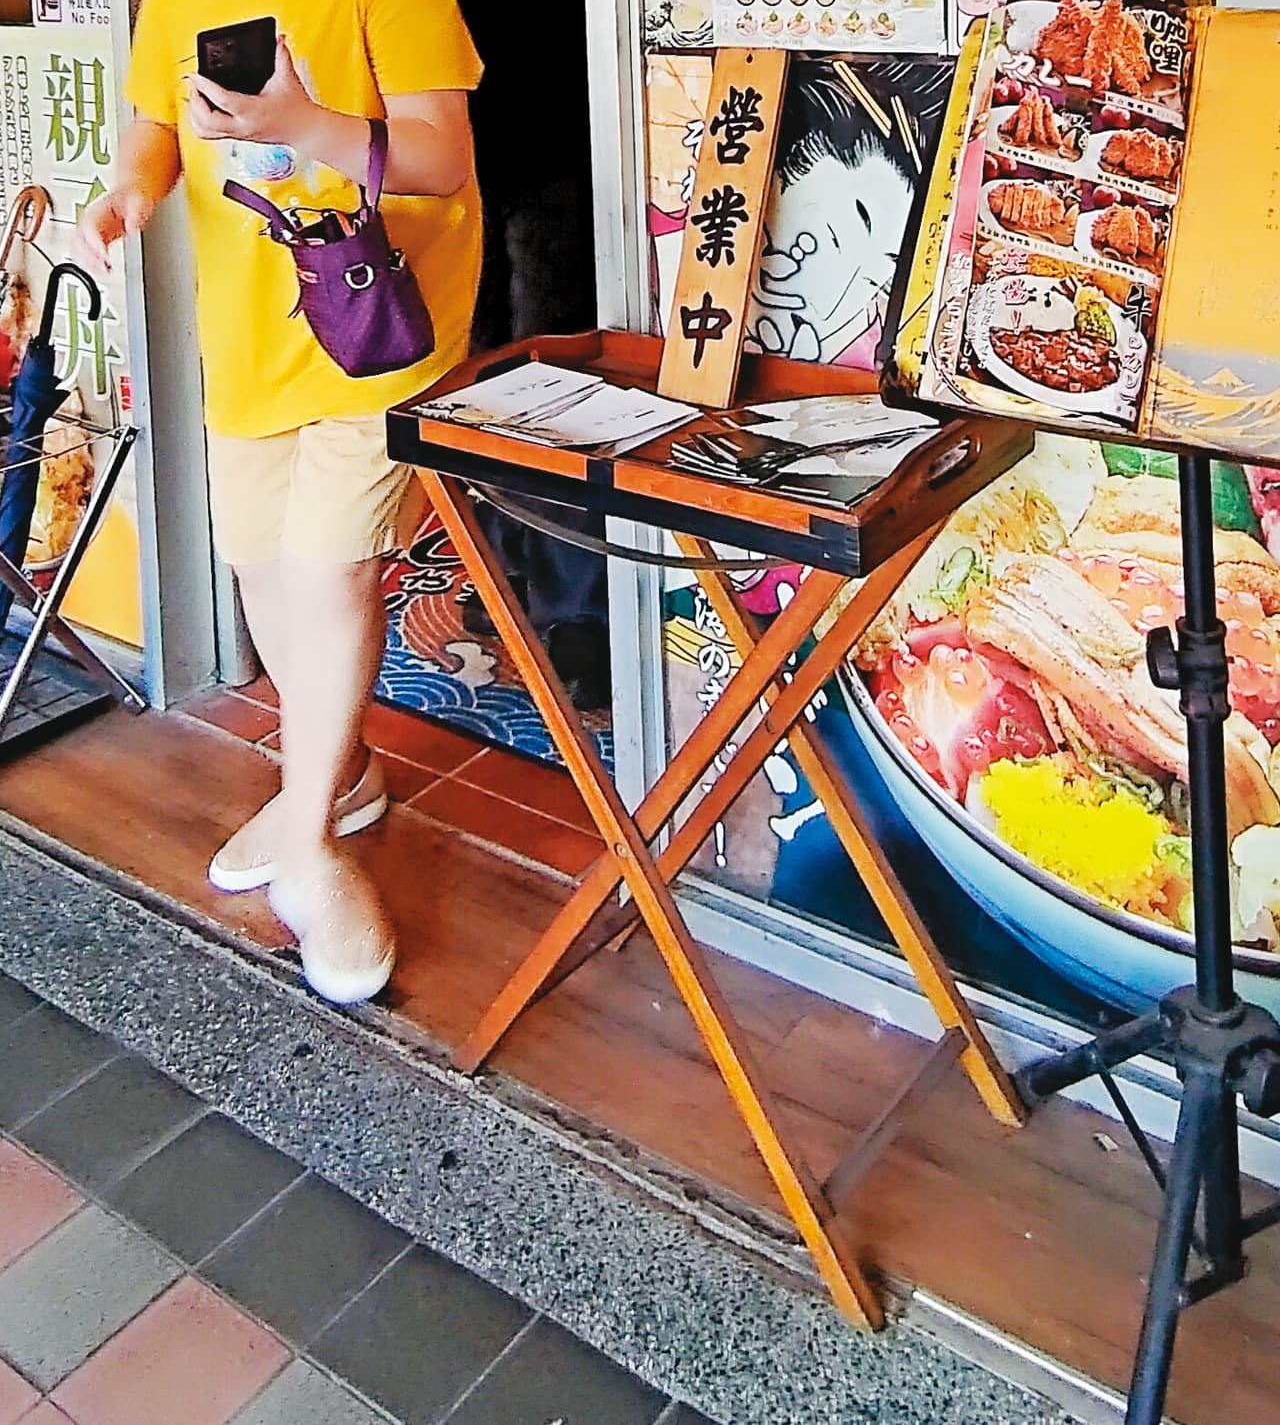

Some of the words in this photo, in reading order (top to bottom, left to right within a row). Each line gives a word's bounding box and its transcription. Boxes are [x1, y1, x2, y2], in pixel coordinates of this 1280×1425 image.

[72, 12, 85, 24] No
[678, 85, 766, 370] 營業中
